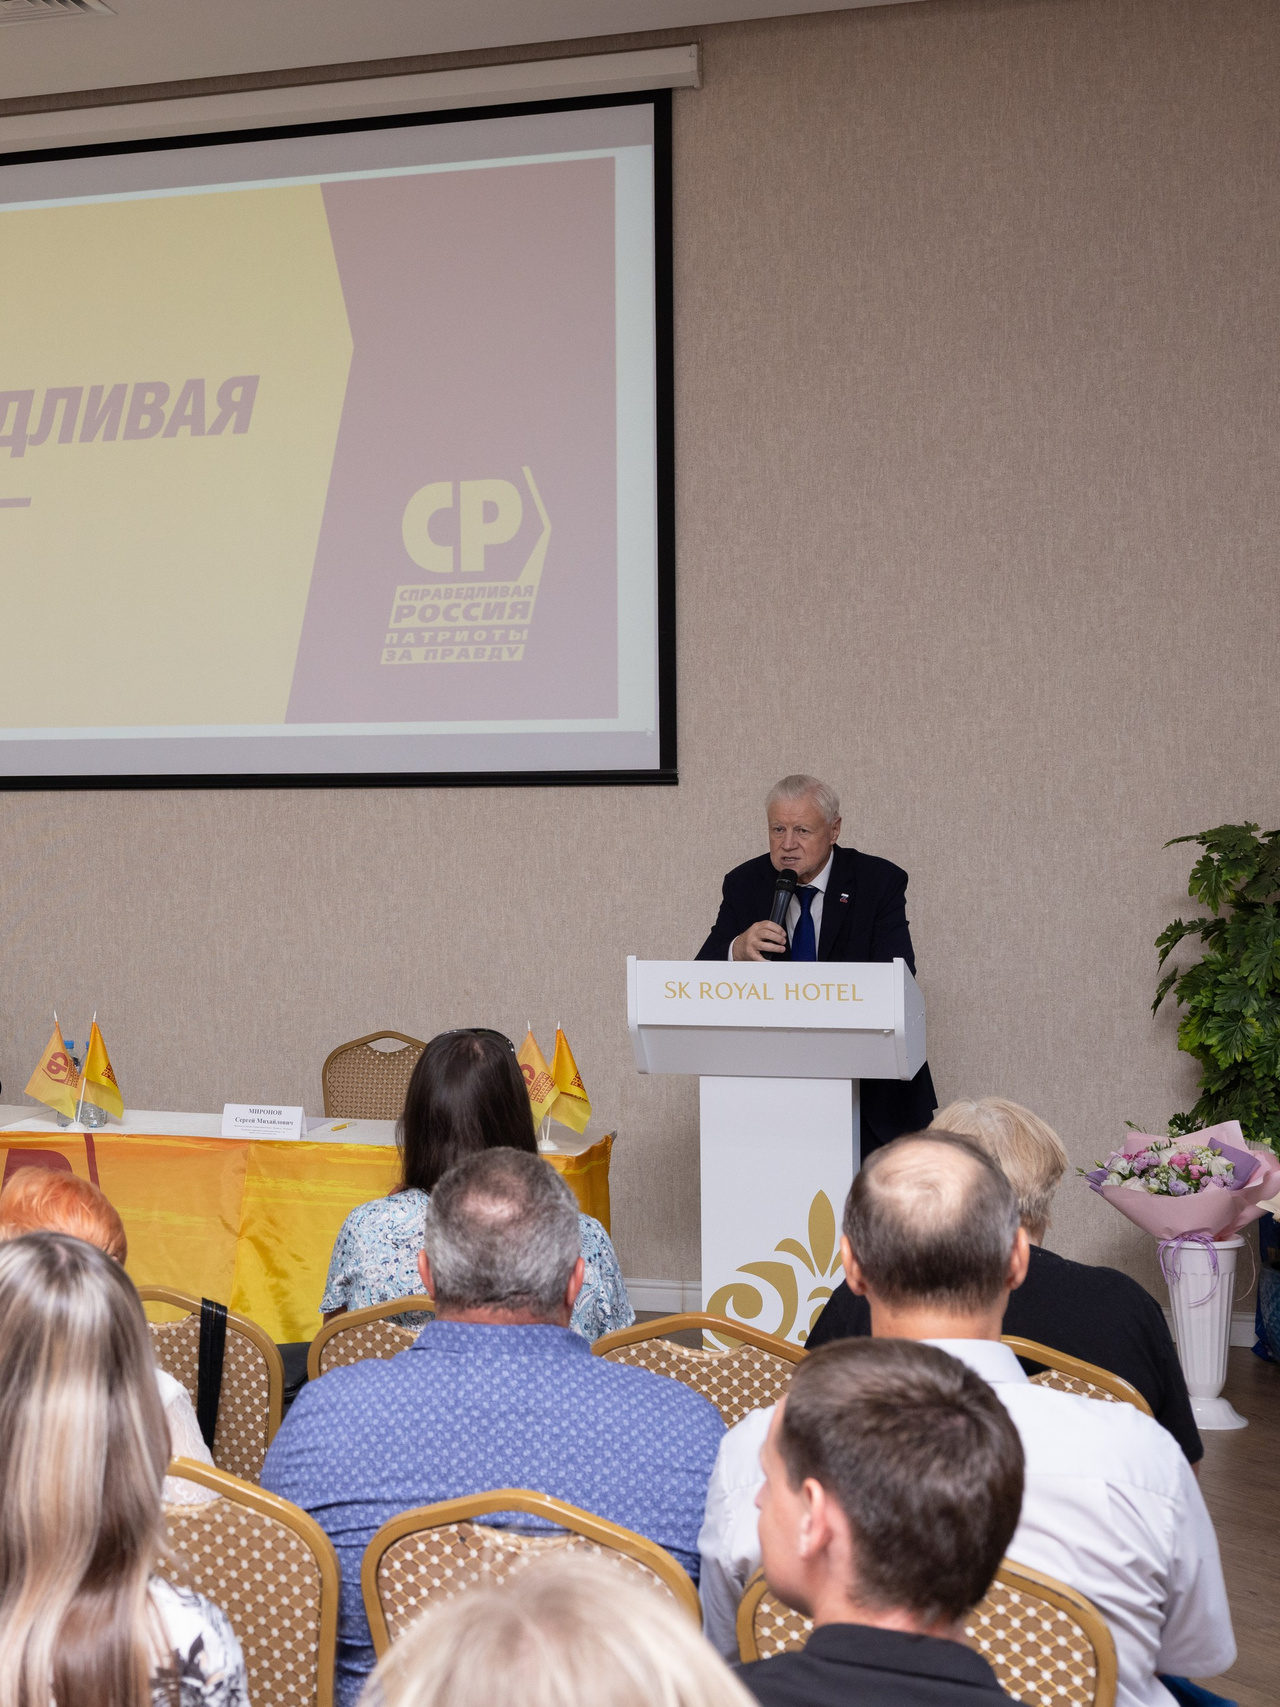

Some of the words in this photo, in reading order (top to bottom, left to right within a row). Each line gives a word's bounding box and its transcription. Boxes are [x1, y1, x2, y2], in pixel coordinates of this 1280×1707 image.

[402, 479, 522, 573] СР
[399, 585, 534, 601] СПРАВЕДЛИВАЯ
[393, 601, 530, 623] РОССИЯ
[385, 630, 528, 644] ПАТРИОТЫ
[385, 649, 413, 662] ЗА
[424, 646, 519, 661] ПРАВДУ
[664, 981, 691, 999] SK
[699, 982, 774, 1001] ROYAL
[784, 983, 863, 1002] HOTEL
